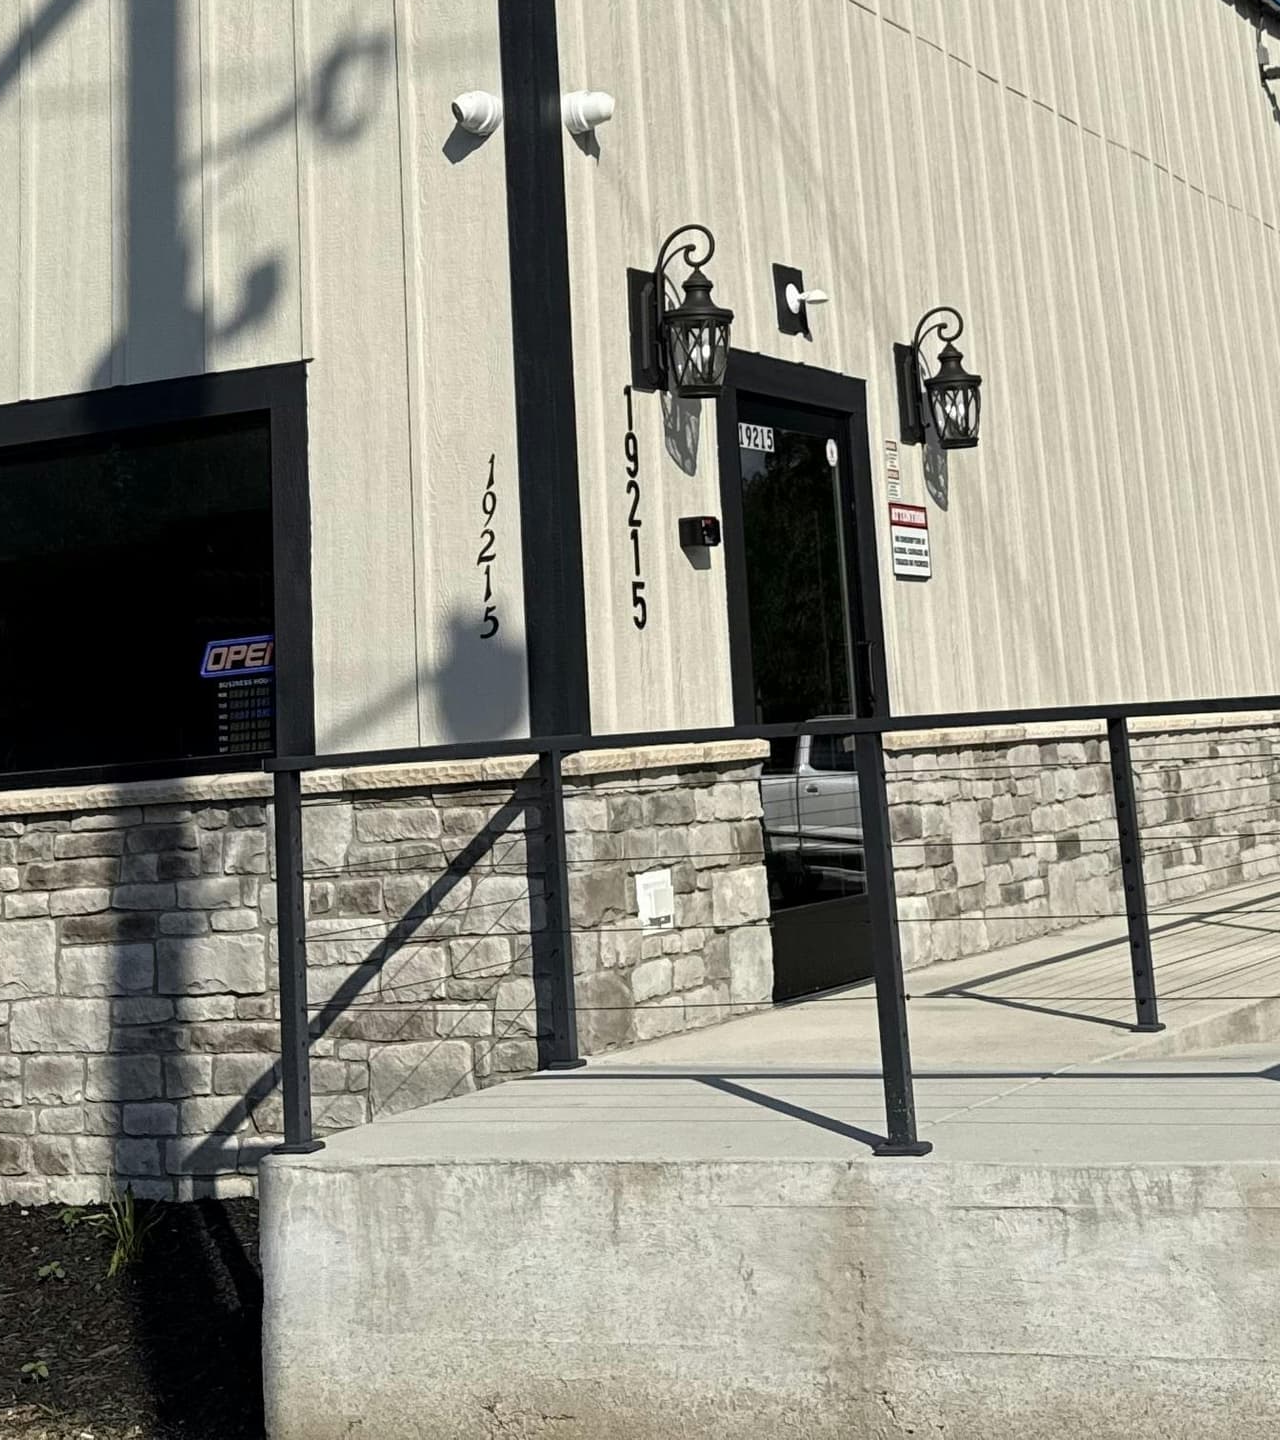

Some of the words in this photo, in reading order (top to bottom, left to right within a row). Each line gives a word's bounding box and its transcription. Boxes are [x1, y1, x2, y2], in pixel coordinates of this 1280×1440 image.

[623, 384, 647, 630] 19215
[739, 423, 773, 450] 19215
[477, 453, 499, 639] 19215
